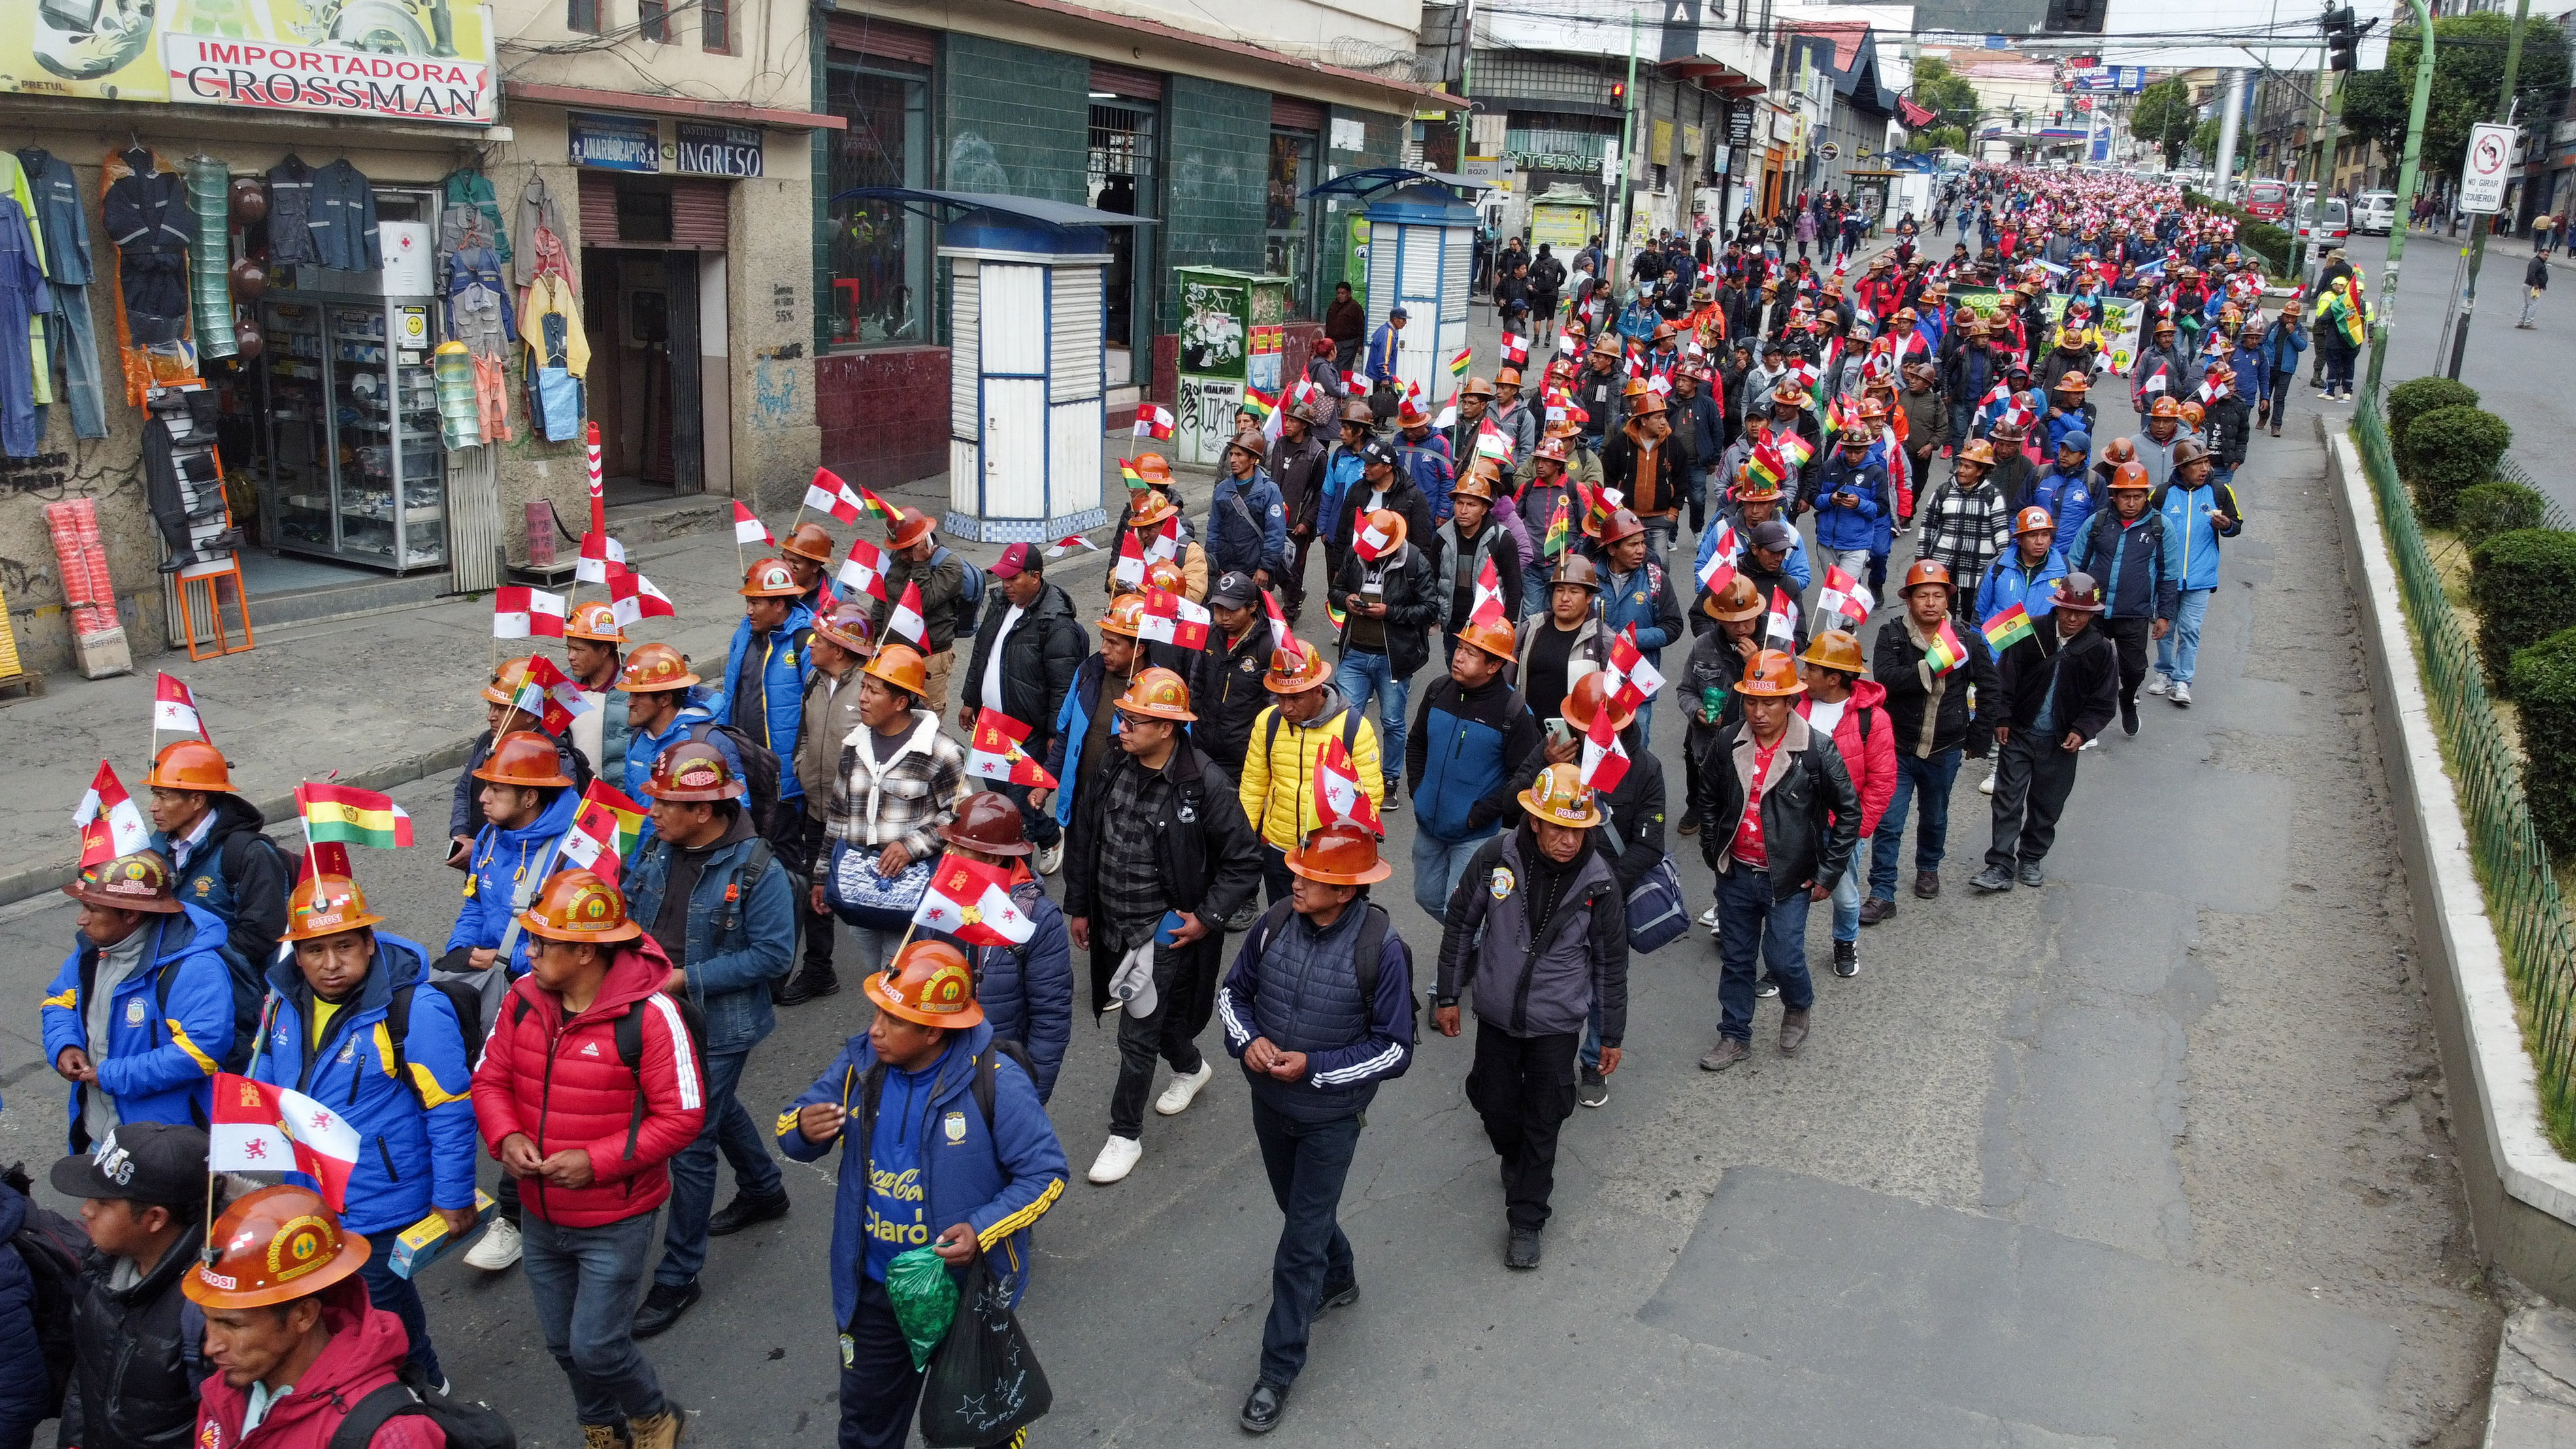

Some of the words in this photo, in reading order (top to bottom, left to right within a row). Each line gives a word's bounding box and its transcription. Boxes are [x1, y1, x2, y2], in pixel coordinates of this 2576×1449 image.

[1671, 2, 1690, 22] A
[375, 39, 402, 47] TRUPER
[199, 41, 469, 85] IMPORTADORA
[21, 80, 66, 92] PRETUL
[188, 66, 478, 118] CROSSMAN
[682, 124, 725, 138] INSTITUTO
[680, 141, 761, 177] INGRESO
[2467, 178, 2476, 186] NO
[2479, 179, 2500, 188] GIRAR
[1744, 182, 1753, 208] LETR
[2464, 192, 2497, 203] IZQUIERDA
[776, 310, 795, 323] 55%
[1276, 677, 1306, 686] POTOSI
[1746, 680, 1777, 691] POTOSI
[679, 771, 718, 787] UNIFICADA
[1555, 808, 1587, 820] POTOSI
[106, 884, 140, 894] ROSARIO
[307, 912, 343, 929] POTOSI
